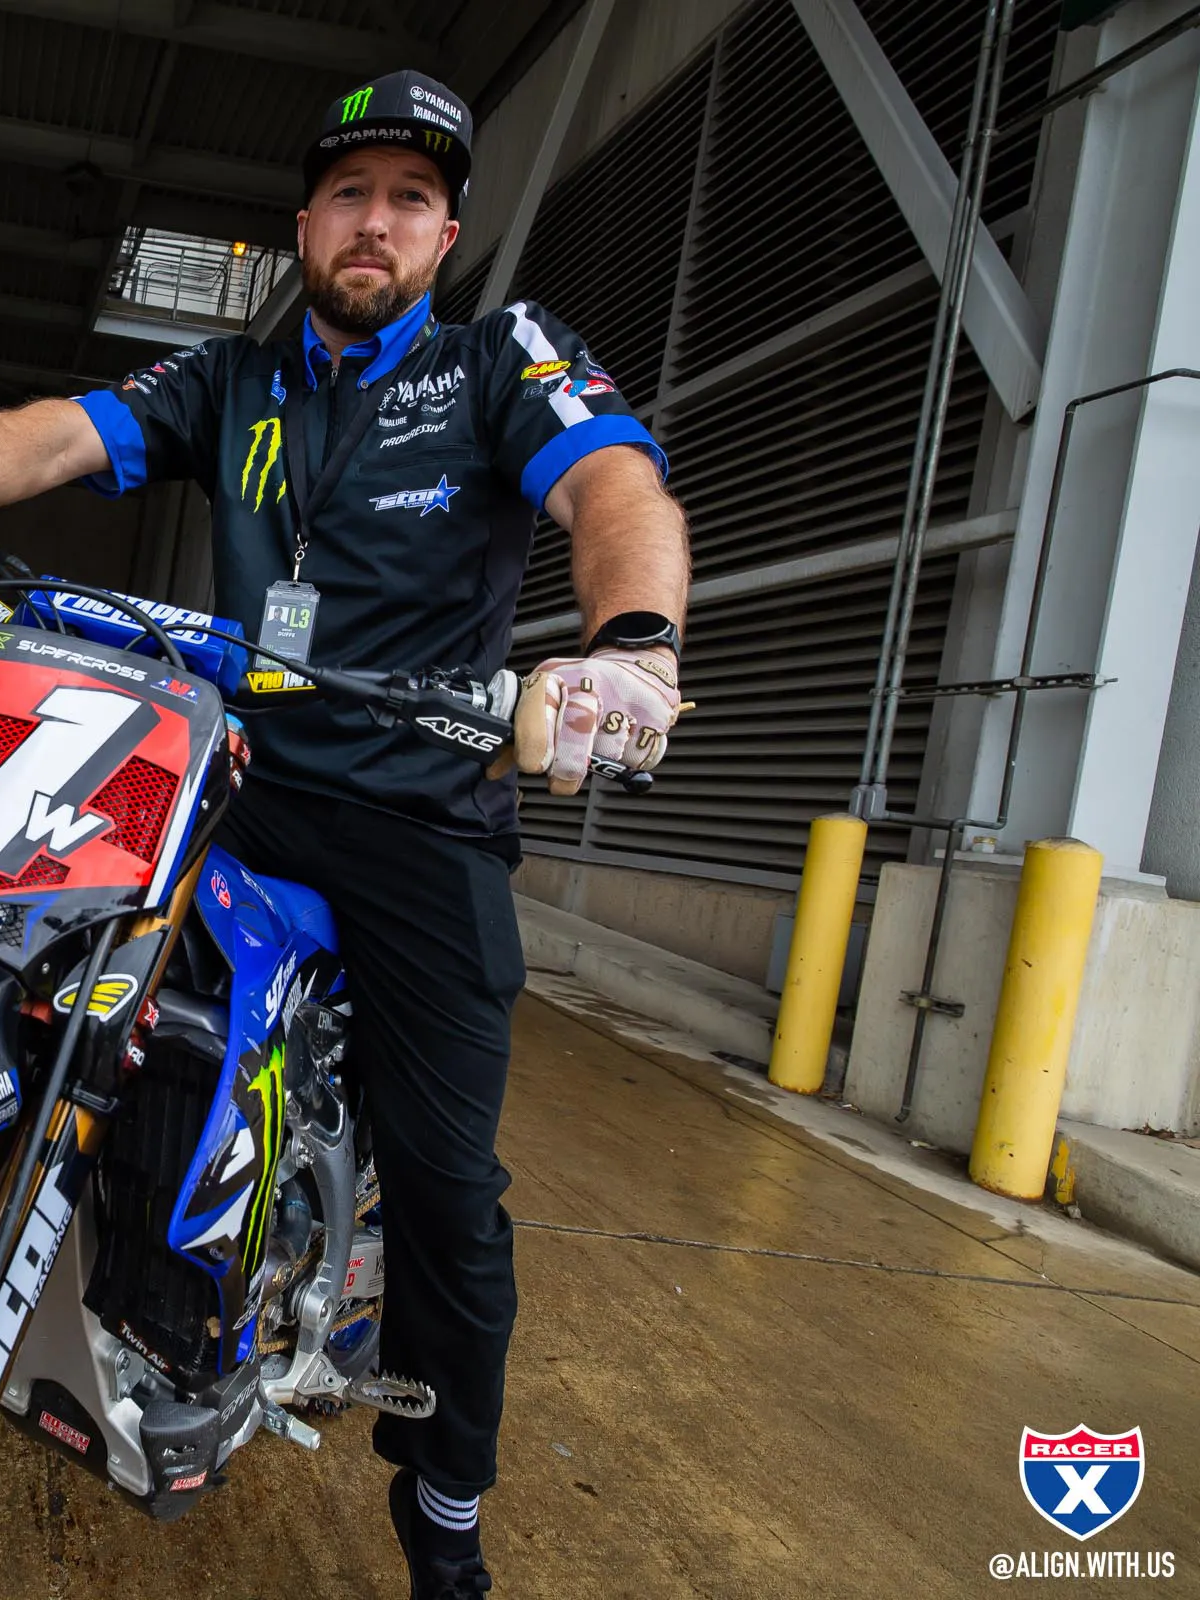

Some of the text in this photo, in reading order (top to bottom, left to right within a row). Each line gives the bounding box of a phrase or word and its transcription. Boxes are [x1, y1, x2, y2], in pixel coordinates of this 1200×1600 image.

[424, 90, 462, 123] YAMAHA
[340, 128, 412, 140] YAMAHA
[397, 364, 465, 403] YAMAHA
[521, 360, 571, 380] FMF
[428, 397, 456, 414] YAMAHA
[379, 419, 448, 449] PROGRESSIVE
[289, 607, 311, 629] L3
[16, 639, 148, 682] SUPERCROSS
[415, 716, 502, 752] ARC
[590, 756, 625, 780] RC
[30, 1205, 73, 1310] RACING
[121, 1321, 170, 1372] Twin Air
[42, 1412, 90, 1446] LIGHT
